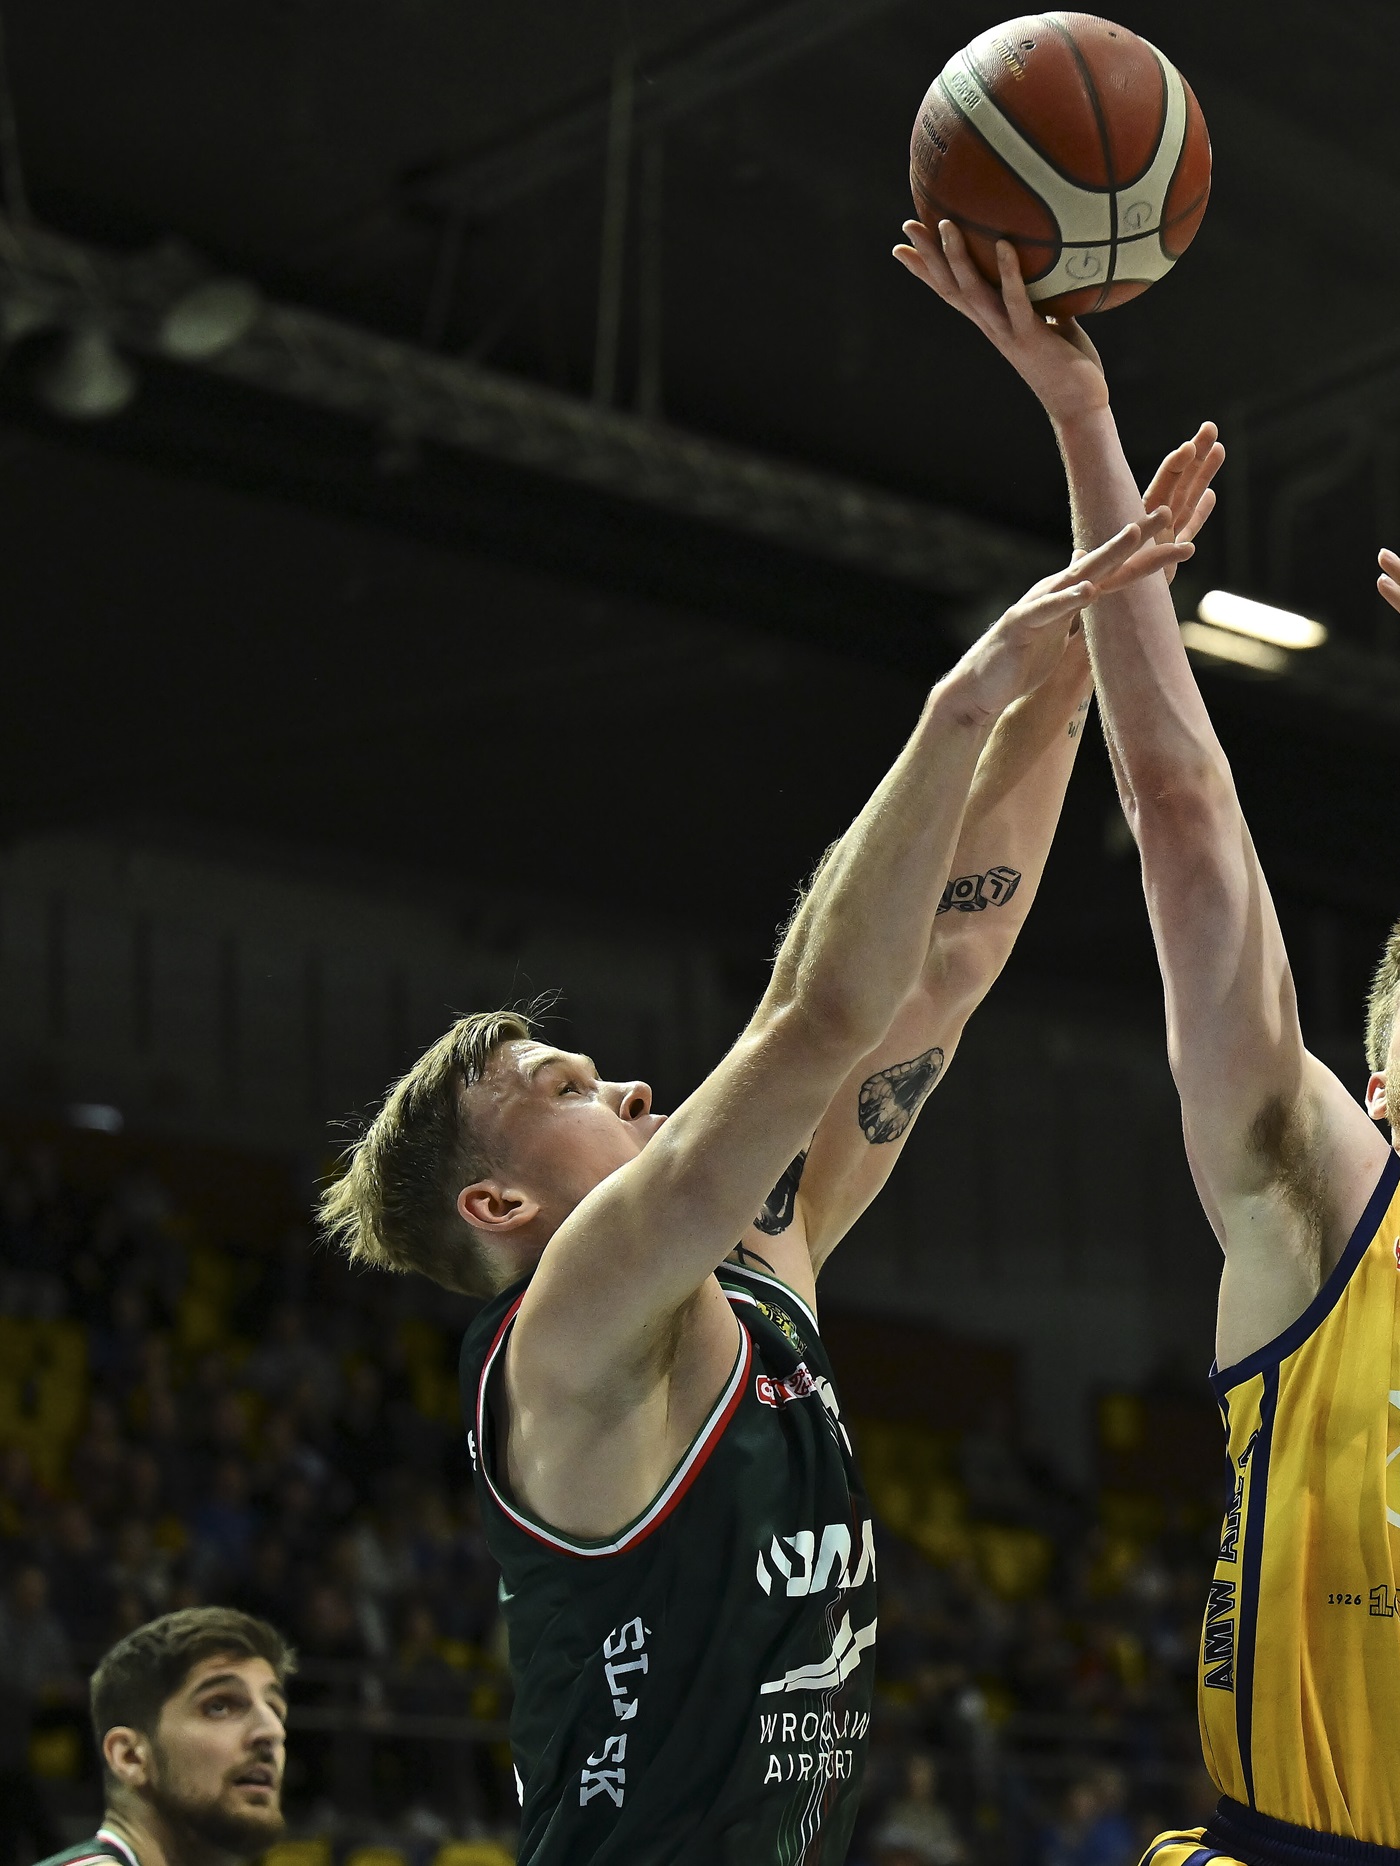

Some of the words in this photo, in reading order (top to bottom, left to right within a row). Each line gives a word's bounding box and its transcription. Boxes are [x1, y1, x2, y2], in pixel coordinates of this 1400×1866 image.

[1327, 1592, 1363, 1606] 1926
[1203, 1580, 1236, 1693] AMW
[763, 1749, 853, 1785] AIRPORT
